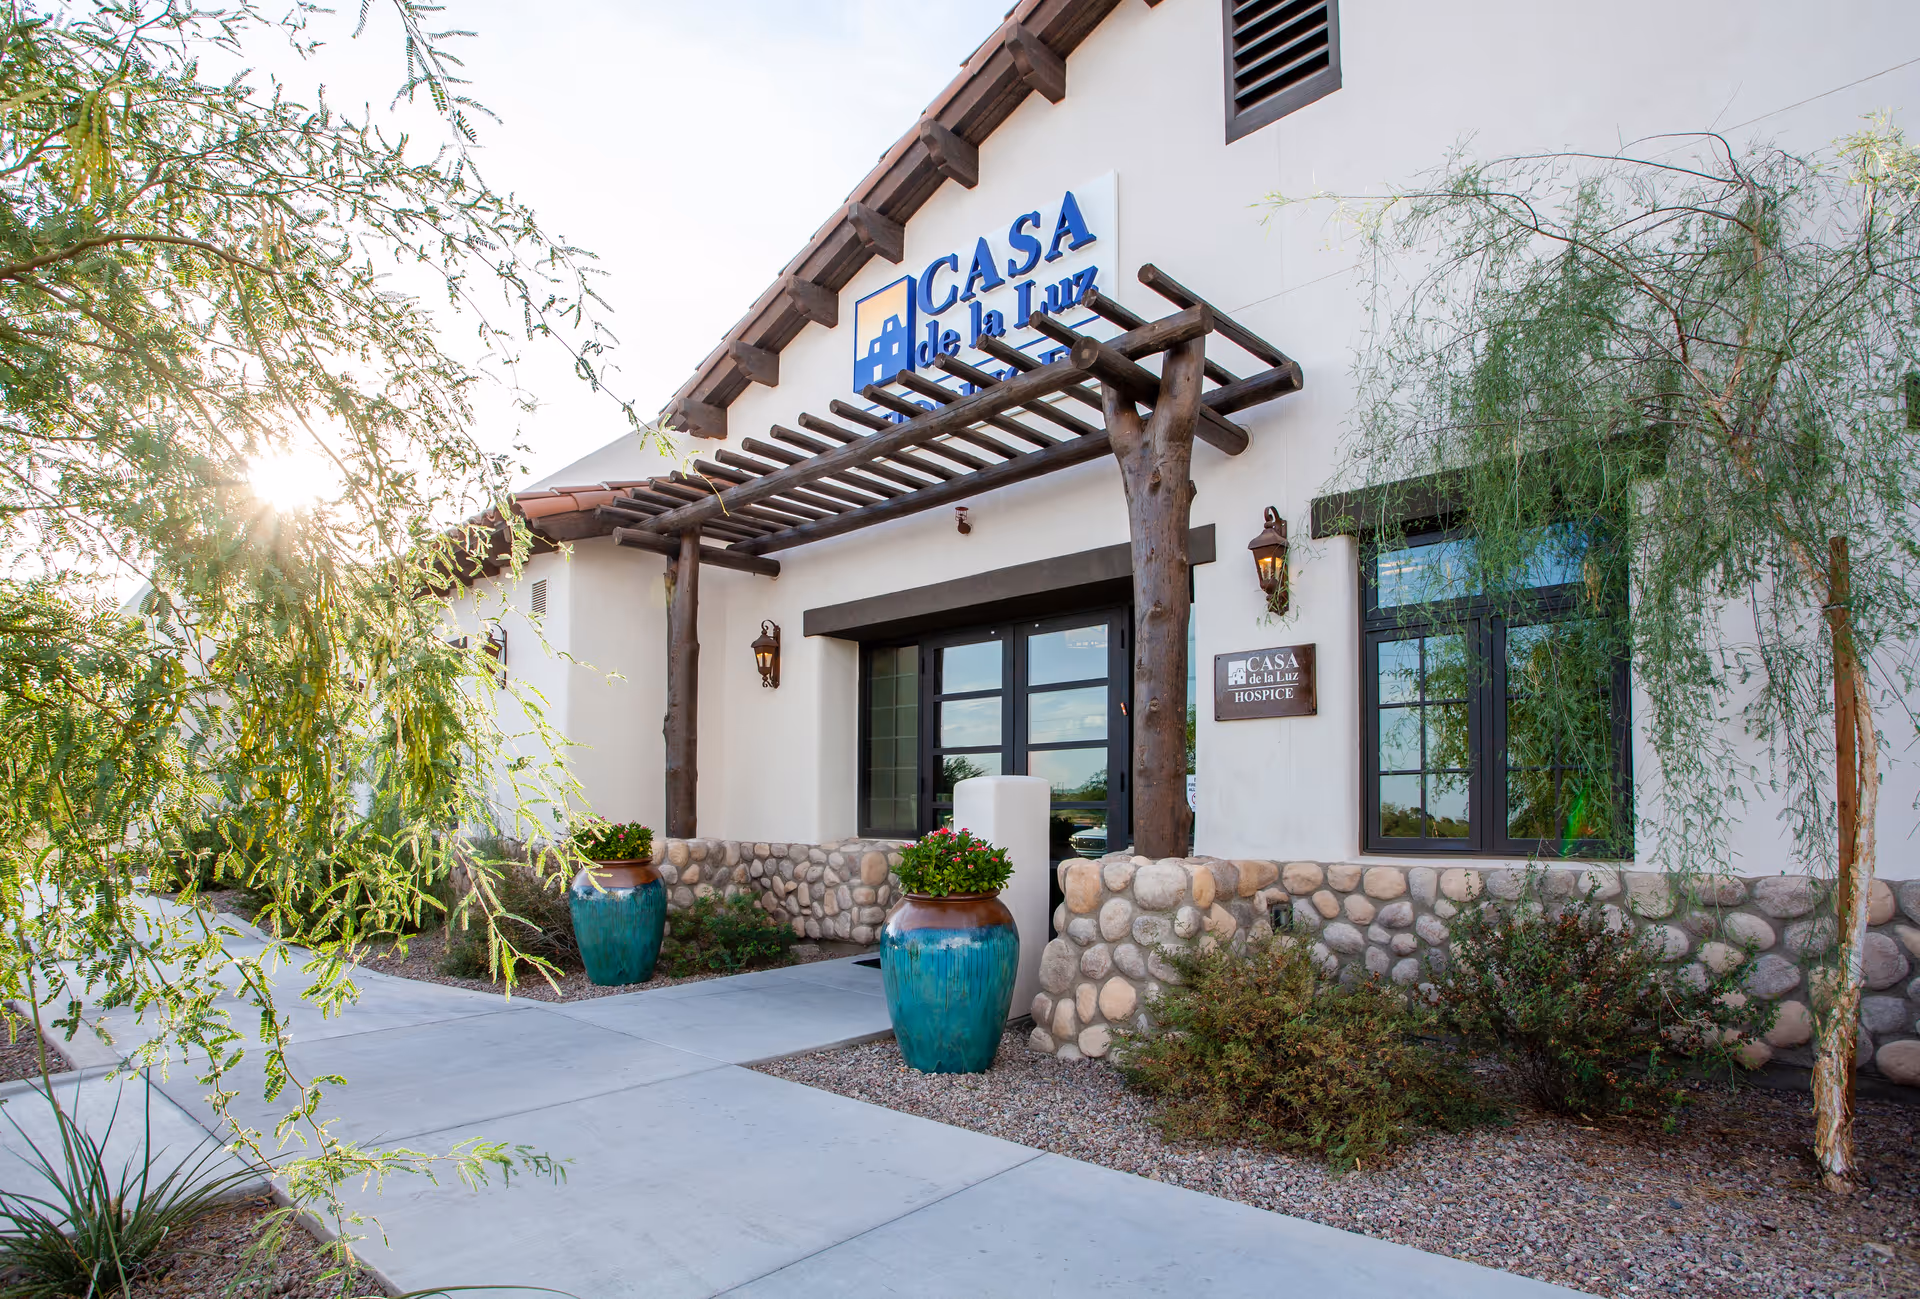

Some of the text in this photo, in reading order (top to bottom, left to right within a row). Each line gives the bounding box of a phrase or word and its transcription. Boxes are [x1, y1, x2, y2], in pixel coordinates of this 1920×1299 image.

[917, 190, 1097, 316] CASA
[915, 264, 1099, 369] de la Luz
[1246, 652, 1300, 672] CASA
[1249, 671, 1299, 685] de la Luz
[1234, 687, 1294, 703] HOSPICE
